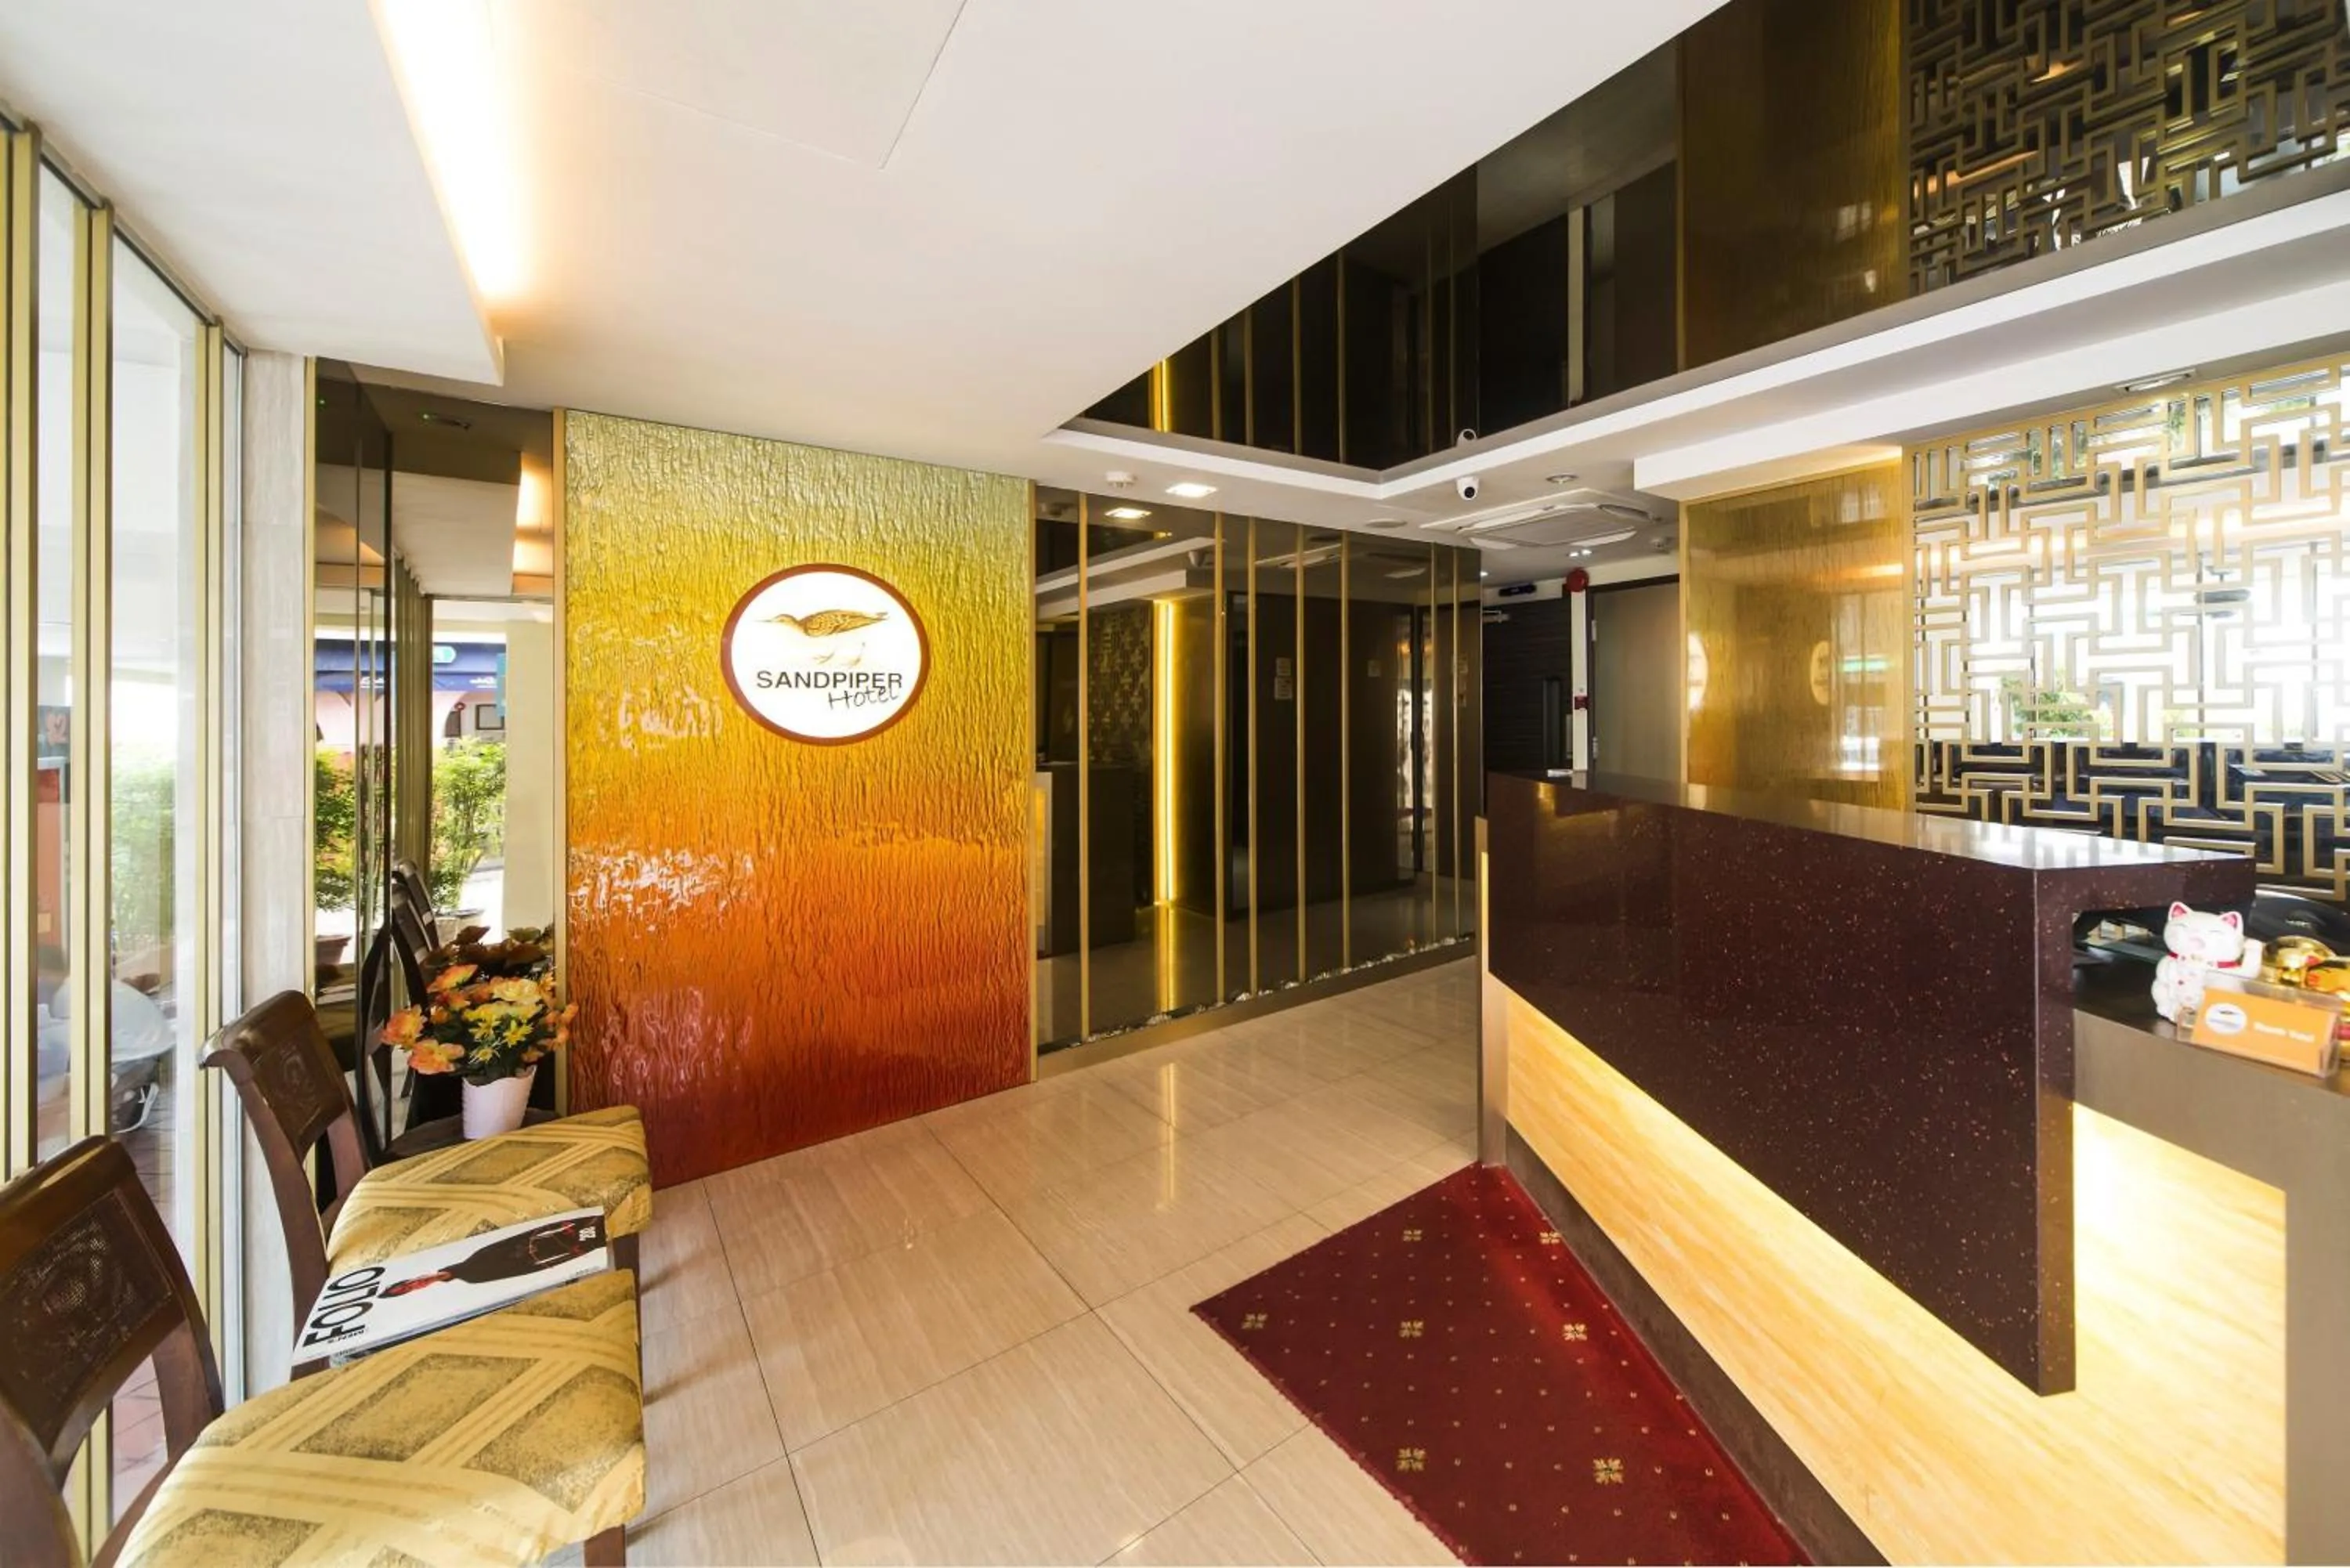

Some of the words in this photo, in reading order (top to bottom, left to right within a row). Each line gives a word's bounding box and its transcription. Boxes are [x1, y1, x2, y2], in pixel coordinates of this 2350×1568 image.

[756, 670, 902, 689] SANDPIPER
[827, 685, 899, 710] Hotel
[303, 1266, 386, 1347] FOLIO
